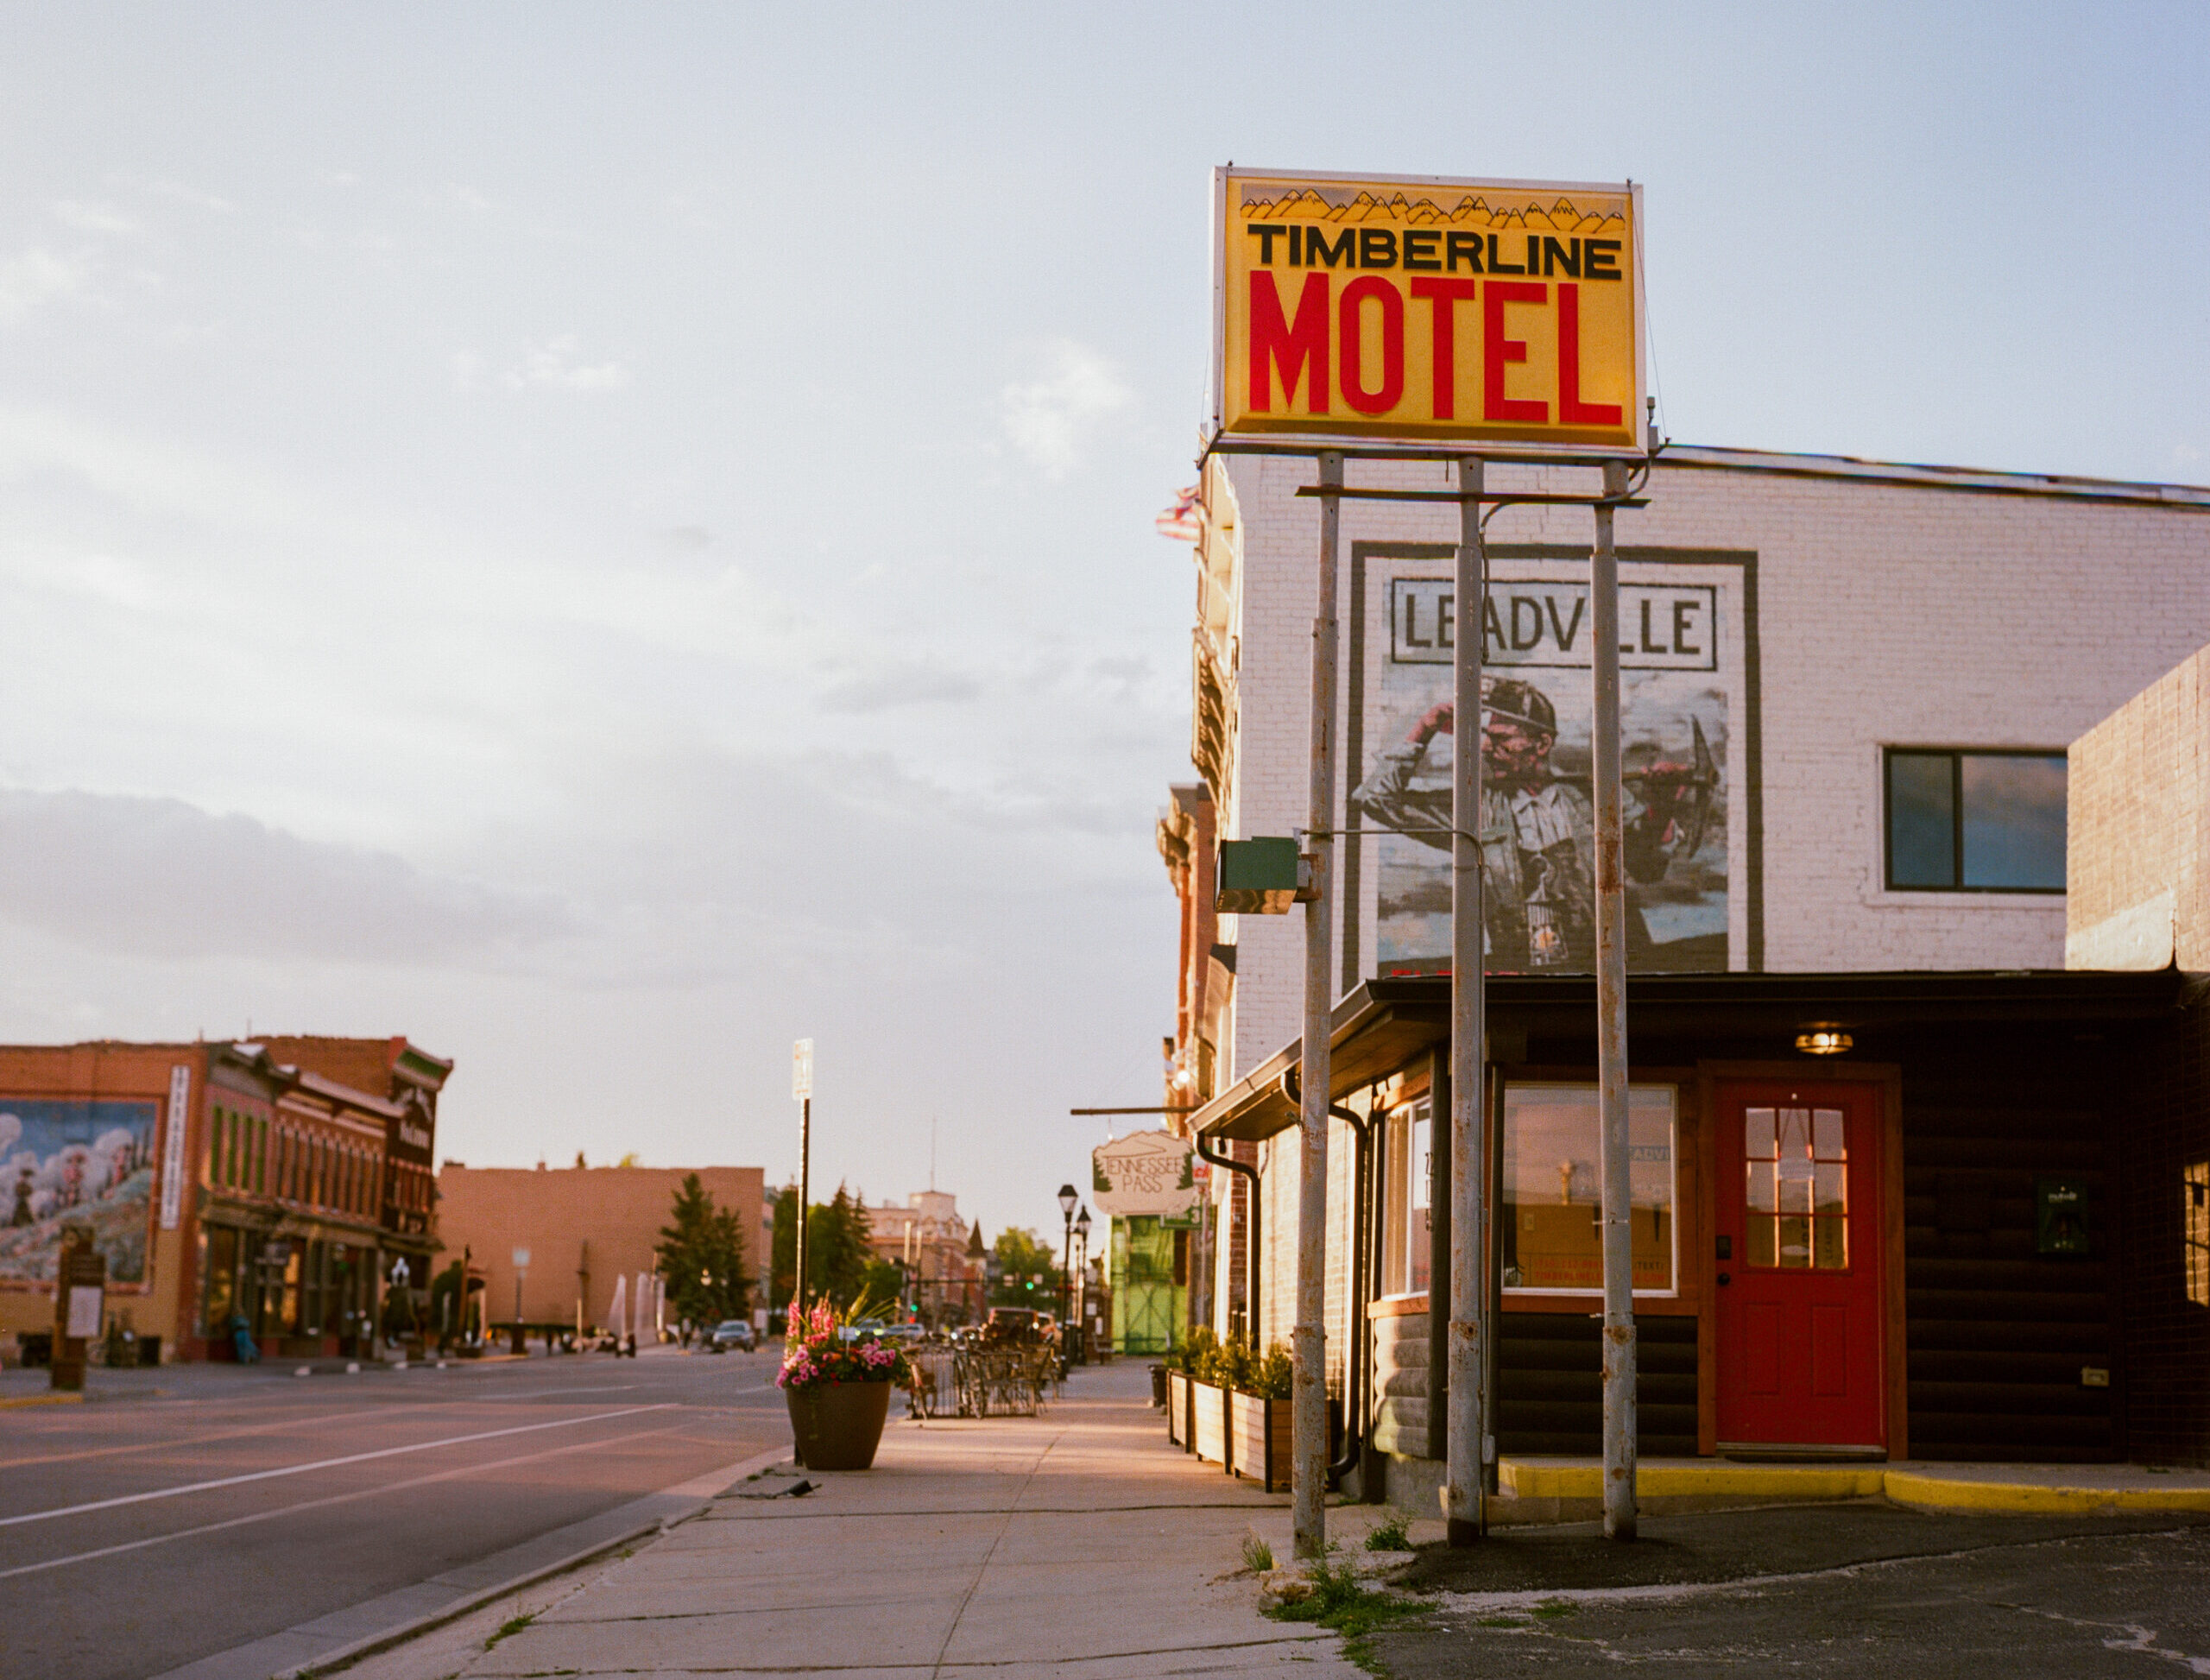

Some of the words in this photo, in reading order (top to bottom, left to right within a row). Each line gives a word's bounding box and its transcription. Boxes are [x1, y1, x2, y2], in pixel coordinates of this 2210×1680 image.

[1247, 224, 1622, 280] TIMBERLINE
[1249, 270, 1623, 425] MOTEL
[1102, 1156, 1183, 1175] TENNESSEE
[1122, 1174, 1163, 1193] PASS
